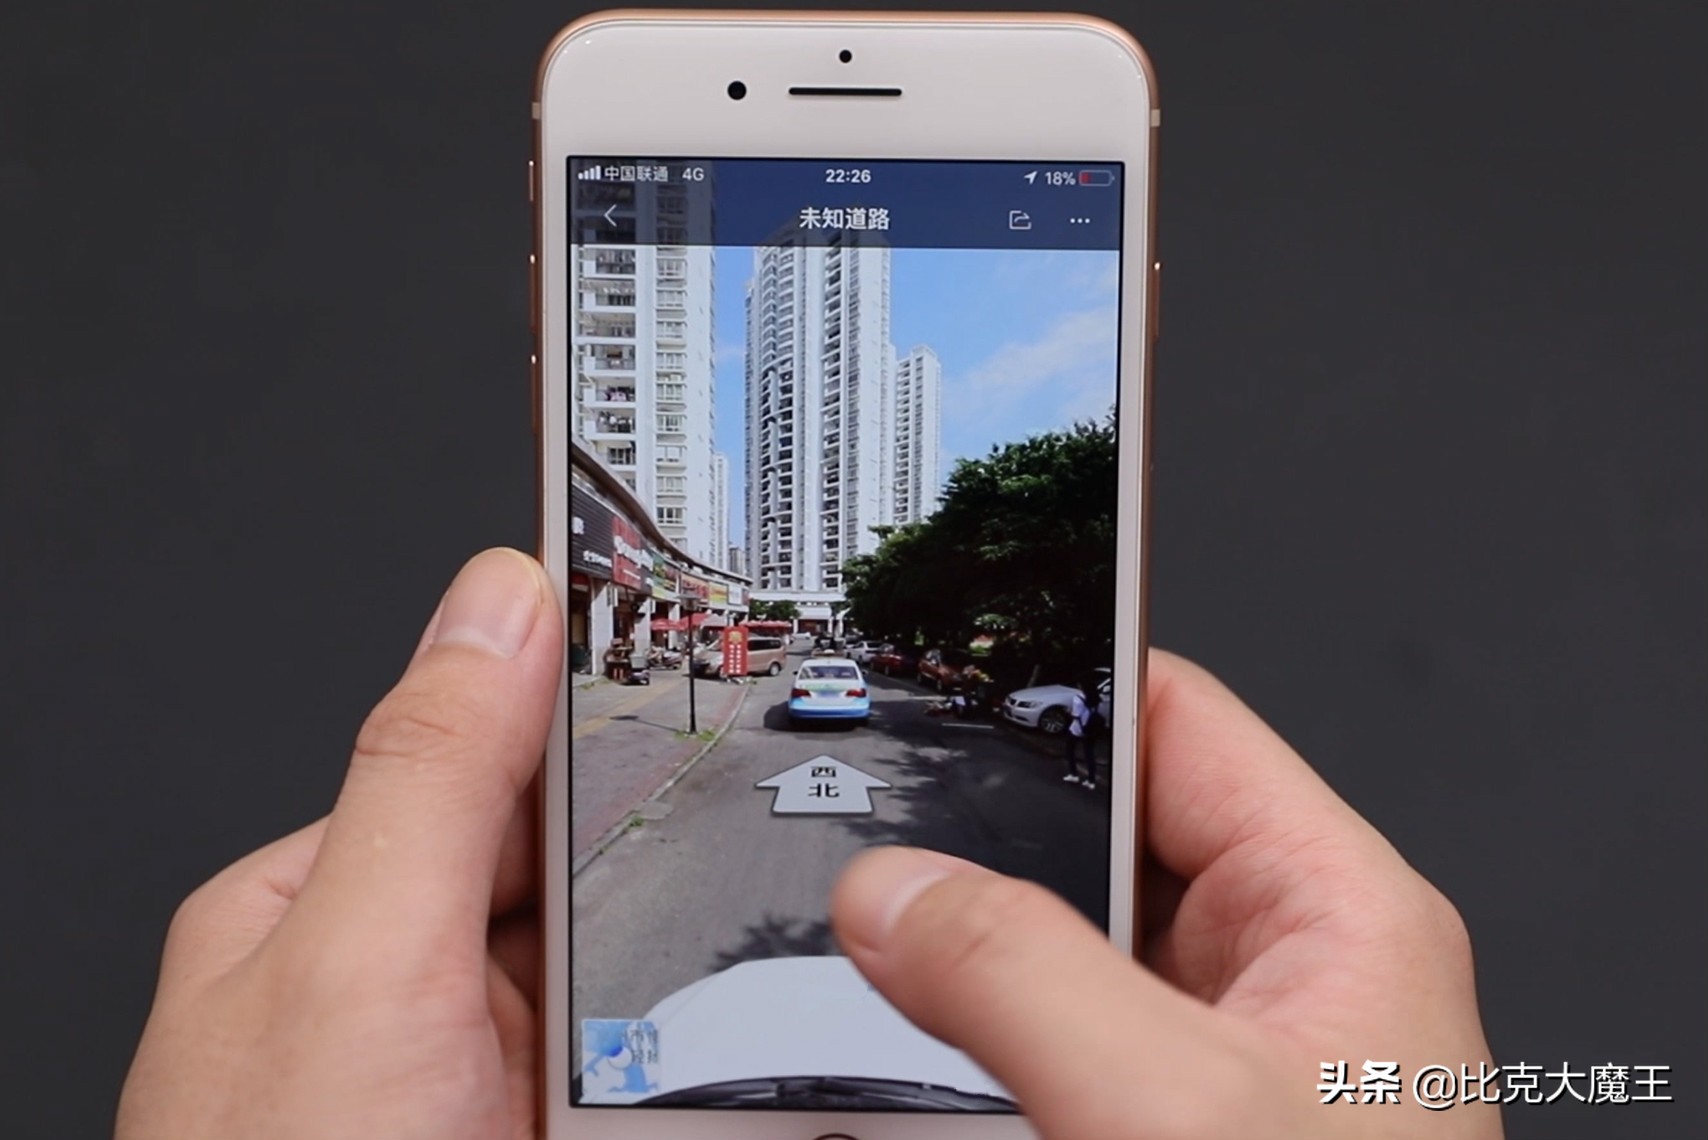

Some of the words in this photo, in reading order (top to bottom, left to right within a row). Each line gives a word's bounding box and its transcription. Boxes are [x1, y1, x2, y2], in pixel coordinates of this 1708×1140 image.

[604, 165, 669, 183] 中国联通
[682, 167, 705, 182] 4G
[825, 168, 872, 184] 22:26
[1045, 170, 1076, 187] 18%
[799, 207, 890, 232] 未知道路
[808, 765, 840, 798] 西北
